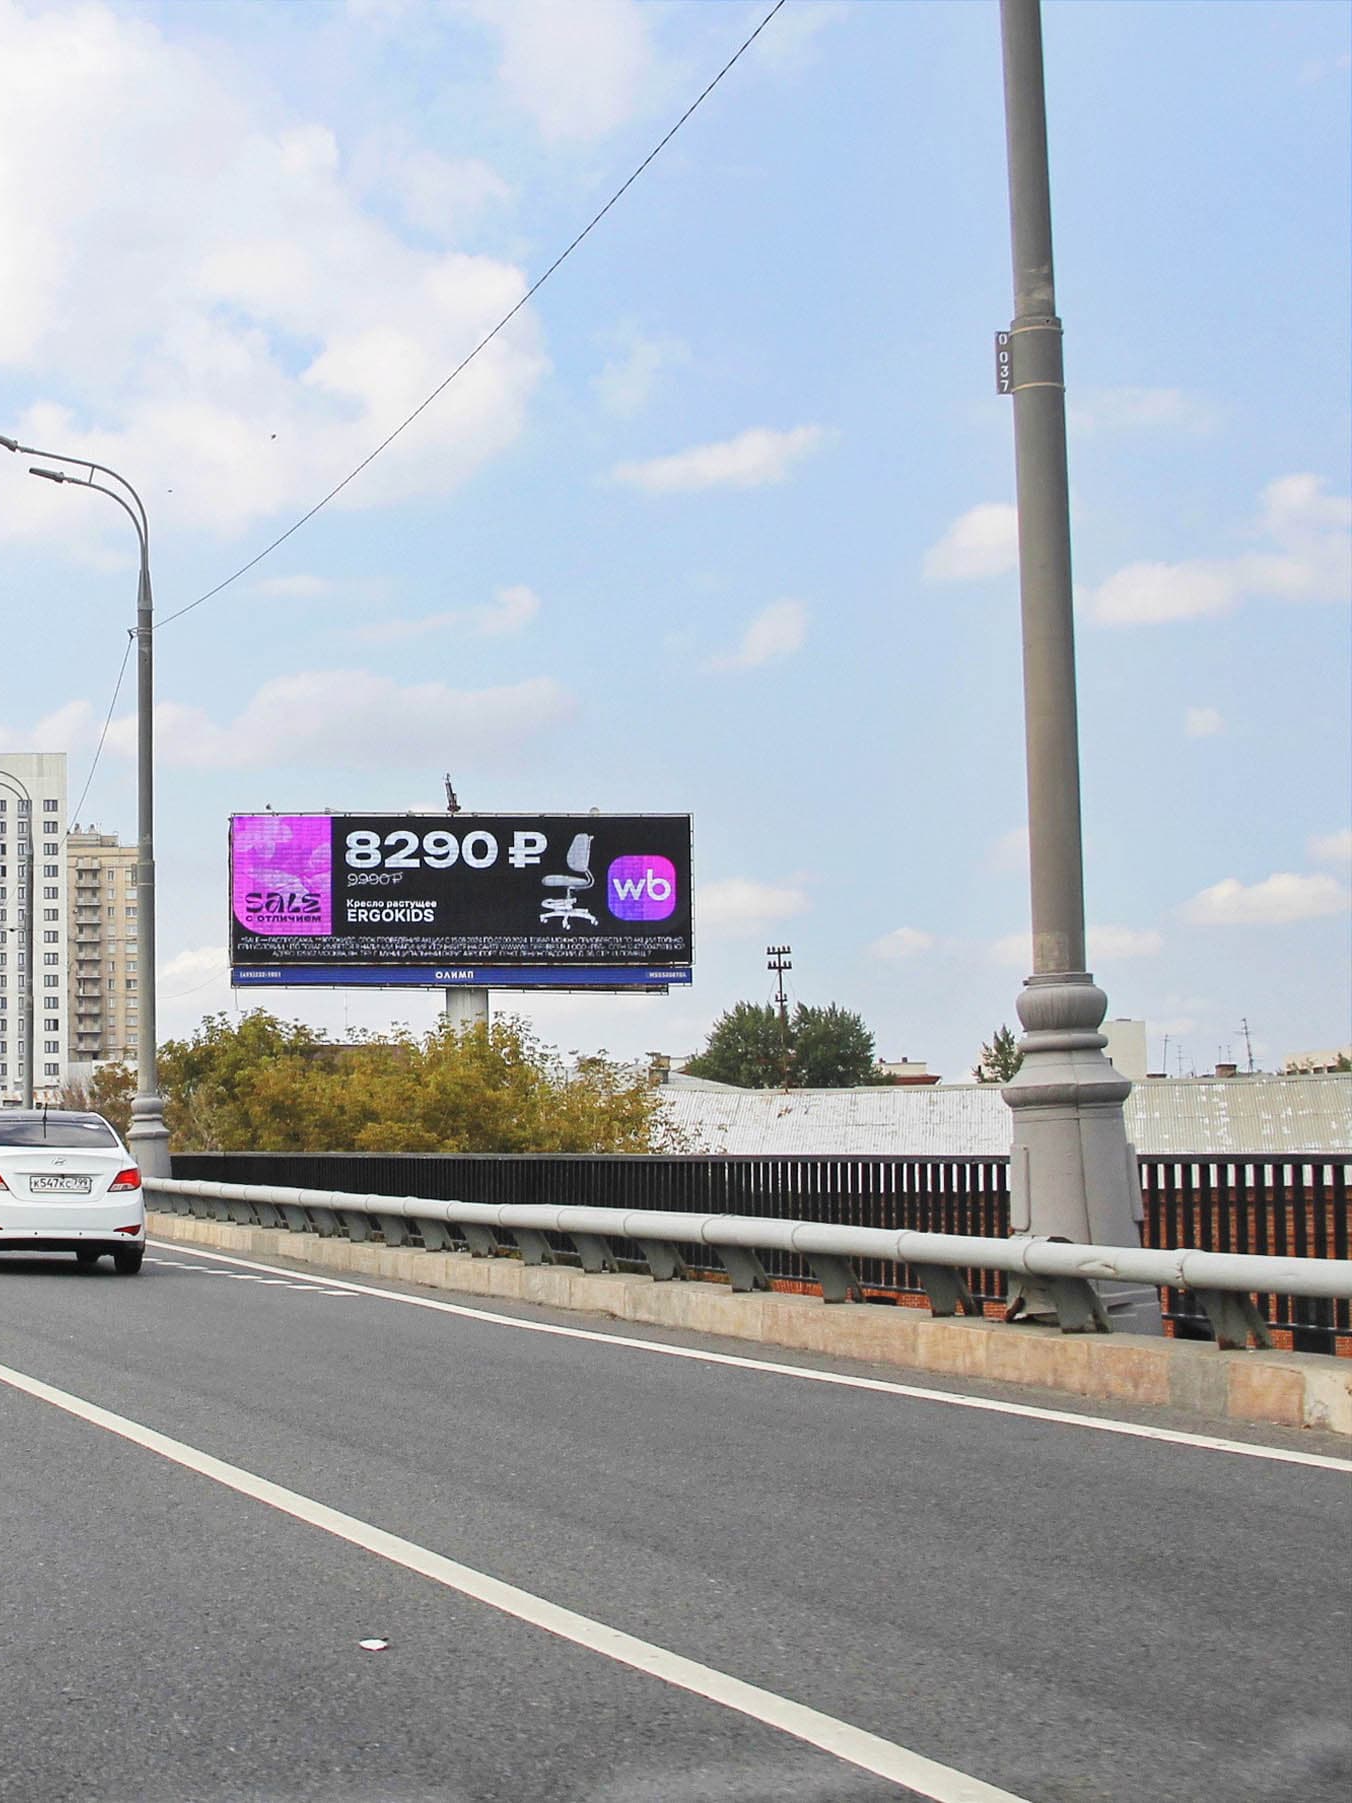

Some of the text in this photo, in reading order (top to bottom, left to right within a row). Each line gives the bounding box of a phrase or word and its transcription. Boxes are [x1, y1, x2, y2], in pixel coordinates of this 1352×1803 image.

[345, 830, 499, 869] 8290
[612, 868, 672, 901] wb
[346, 899, 437, 909] Кресло растущее
[347, 909, 435, 922] ERGOKIDS
[435, 970, 474, 979] ОЛИМП
